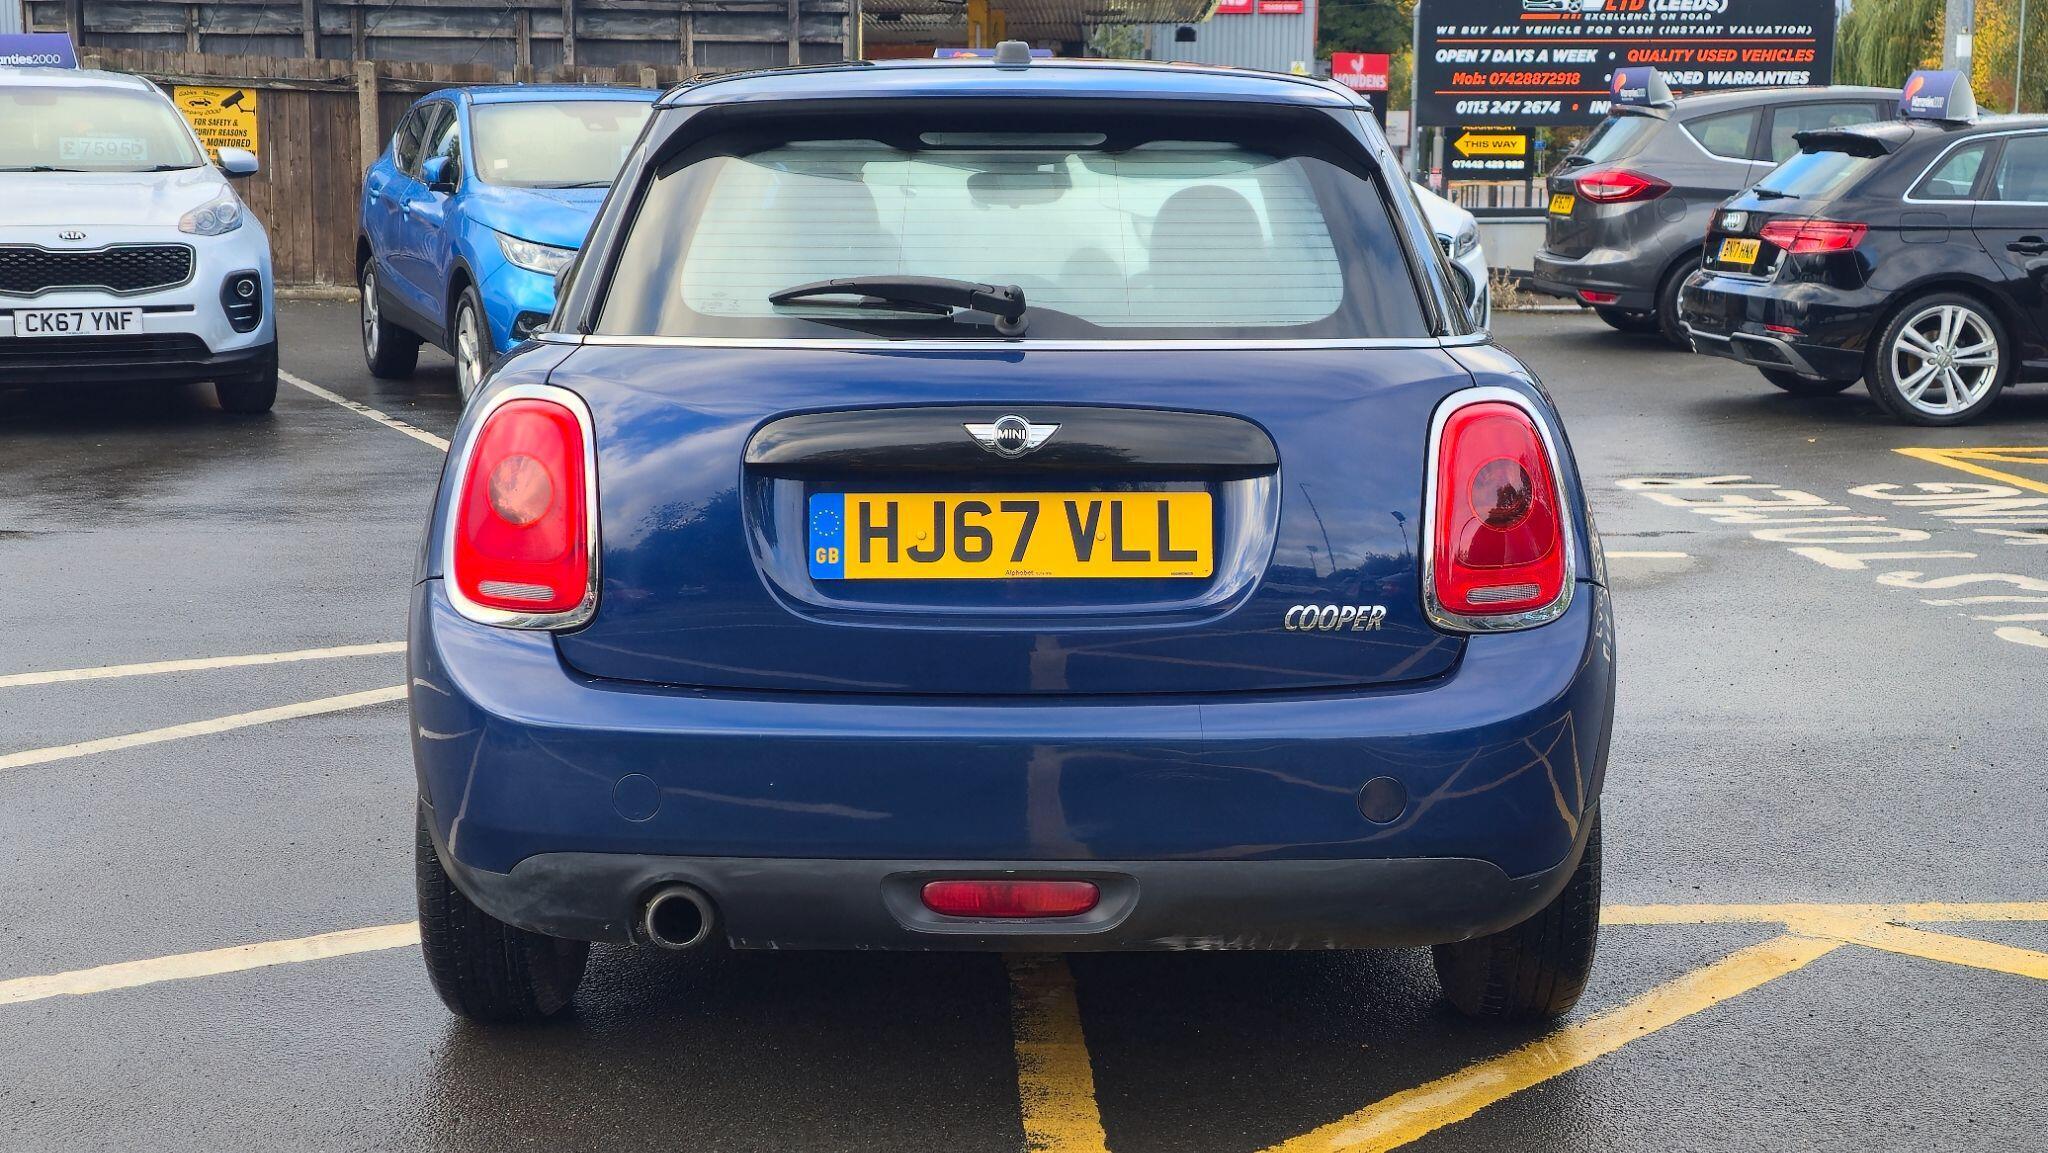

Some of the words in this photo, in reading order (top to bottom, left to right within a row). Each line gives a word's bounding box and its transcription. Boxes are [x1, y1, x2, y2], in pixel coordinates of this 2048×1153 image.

[1436, 26, 1456, 34] WE
[1461, 26, 1487, 34] BUY
[1492, 26, 1520, 34] ANY
[1525, 26, 1582, 34] VEHICLE
[1586, 26, 1613, 34] FOR
[1618, 26, 1654, 34] CASH
[1658, 26, 1724, 35] (INSTANT
[1729, 26, 1813, 35] VALUATION)
[1435, 49, 1478, 62] OPEN
[1480, 50, 1491, 62] 7
[1491, 50, 1536, 62] DAYS
[1535, 50, 1549, 62] A
[1553, 49, 1599, 62] WEEK
[1627, 49, 1695, 62] QUALITY
[1697, 49, 1738, 62] USED
[1741, 49, 1816, 62] VEHICLES
[1452, 72, 1487, 85] Mob:
[1489, 72, 1581, 85] 07428872918
[1657, 71, 1704, 84] NDED
[1707, 71, 1811, 84] WARRANTIES
[1456, 101, 1488, 114] 0113
[1490, 101, 1521, 114] 247
[1521, 101, 1562, 114] 2674
[218, 129, 248, 137] REASONS
[206, 139, 251, 148] MONITORED
[60, 231, 84, 240] KIA
[25, 312, 83, 332] CK67
[90, 311, 133, 331] YNF
[997, 429, 1026, 440] MINI
[858, 500, 1040, 563] HJ67
[1063, 500, 1198, 562] VLL
[815, 547, 839, 564] GB
[1284, 604, 1387, 632] COOPER
